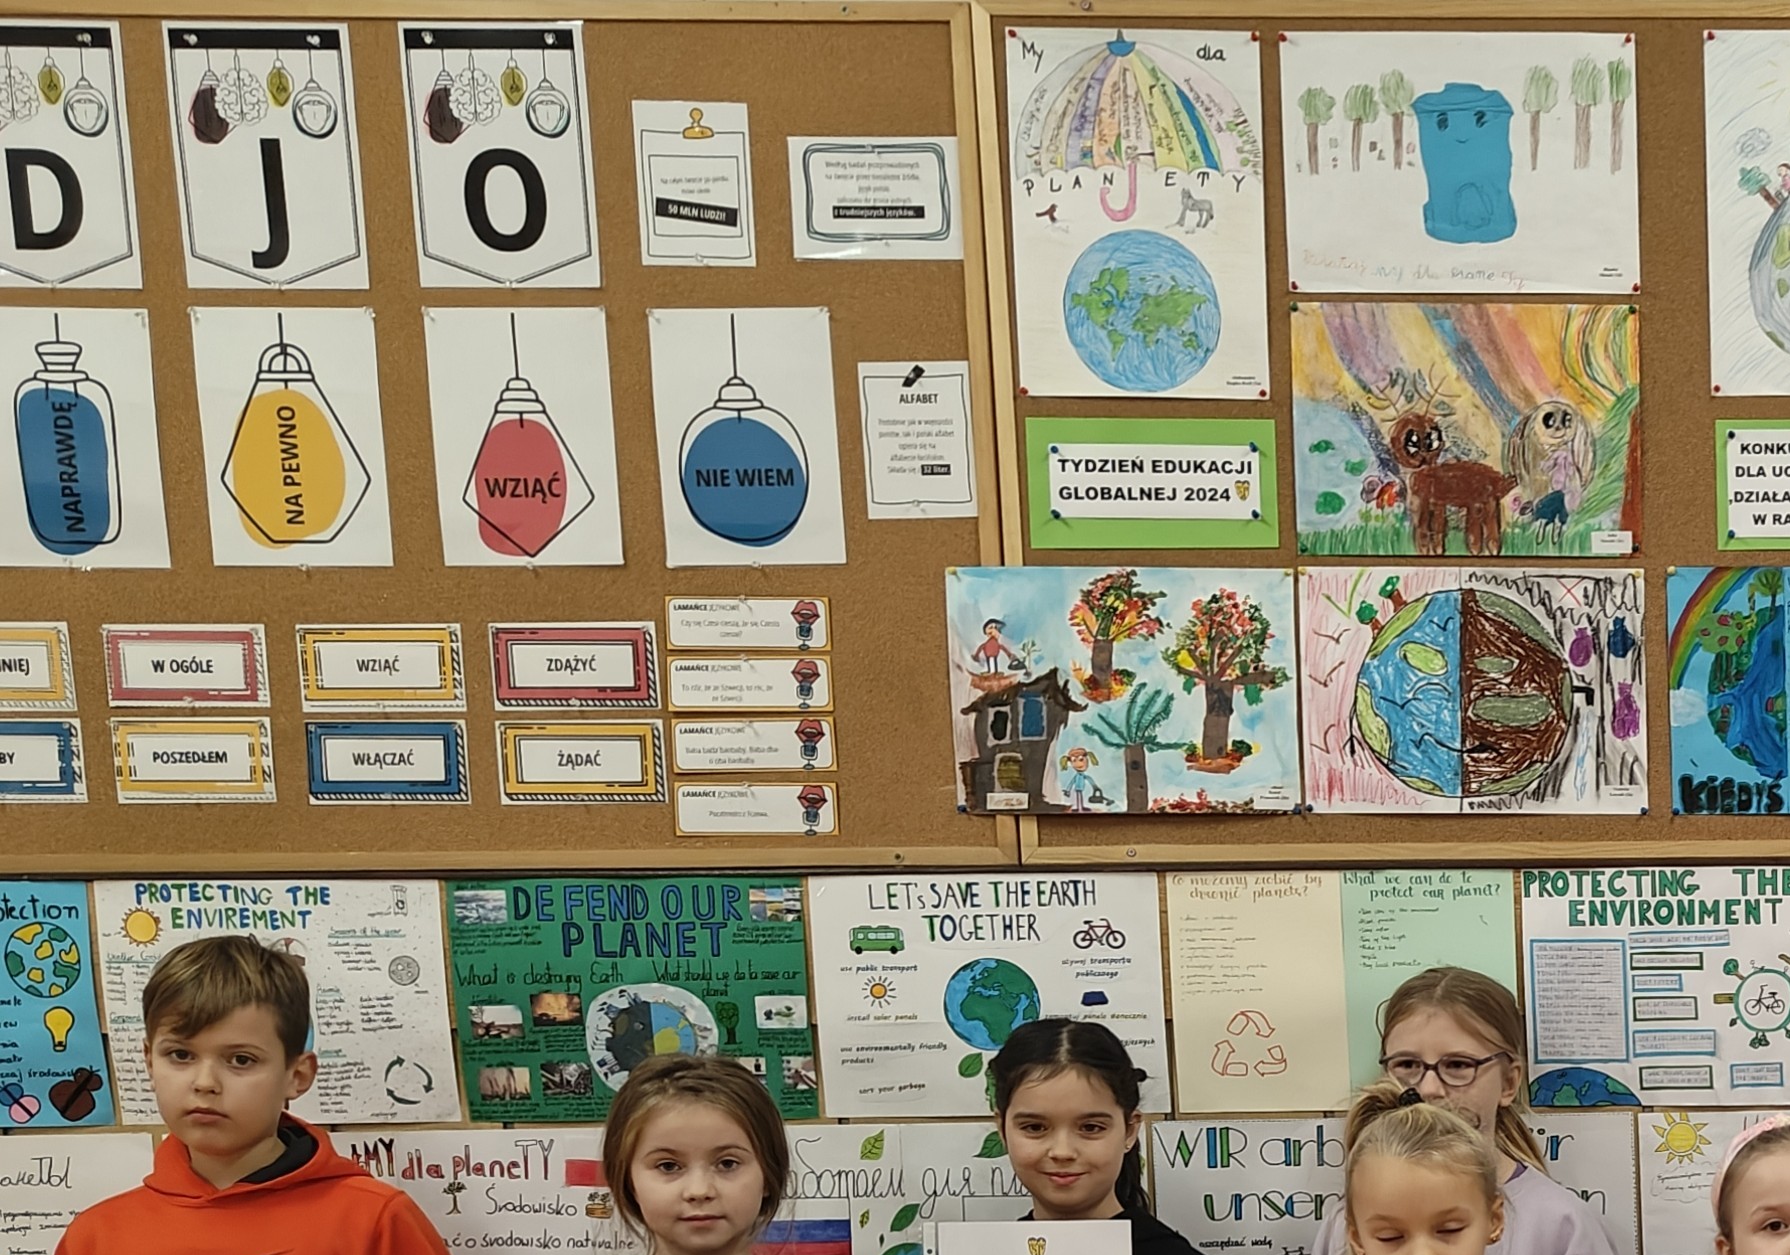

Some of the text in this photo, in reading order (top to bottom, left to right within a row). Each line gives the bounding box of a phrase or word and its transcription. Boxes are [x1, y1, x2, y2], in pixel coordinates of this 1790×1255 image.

[1022, 40, 1227, 73] My dla
[5, 147, 83, 251] D
[251, 138, 282, 269] J
[464, 147, 548, 252] O
[668, 203, 726, 222] 50 MLN LUDZI!
[899, 394, 938, 403] ALFABET
[59, 399, 84, 534] NAPRAWDĘ
[277, 404, 305, 526] NA PEWNO
[694, 465, 796, 490] NIE WIEM
[1057, 454, 1254, 479] TYDZIEŃ EDUKACJI
[1735, 466, 1766, 477] DLA
[484, 469, 563, 506] WZIĄĆ
[1057, 484, 1232, 505] GLOBALNEJ 2024
[1753, 514, 1766, 525] W
[673, 602, 708, 611] ŁAMAŃCE
[151, 654, 214, 675] W OGÓLE
[356, 653, 400, 677] WZIĄĆ
[545, 653, 597, 677] ZDĄŻYĆ
[674, 663, 709, 672] ŁAMAŃCE
[679, 726, 713, 735] ŁAMAŃCE
[151, 748, 228, 767] POSZEDŁEM
[352, 749, 415, 770] WŁĄCZAĆ
[557, 748, 601, 771] ŻĄDAĆ
[682, 789, 717, 798] ŁAMAŃCE
[134, 883, 331, 906] PROTECTING THE
[930, 880, 1096, 909] SAVE THE EARTH
[1523, 869, 1700, 898] PROTECTING
[513, 884, 743, 922] DEFEND OUR
[1568, 898, 1783, 927] ENVIRONMENT
[171, 907, 312, 930] ENVIREMENT
[921, 913, 1041, 942] TOGETHER
[561, 922, 728, 958] PLANET
[454, 963, 498, 987] What
[507, 971, 516, 984] is
[590, 961, 624, 984] Earth
[652, 960, 682, 982] What
[1154, 1126, 1248, 1168] WIR
[402, 1149, 445, 1181] dla
[485, 1183, 577, 1216] Środowisko
[919, 1167, 980, 1219] для
[480, 1235, 561, 1248] środowisko
